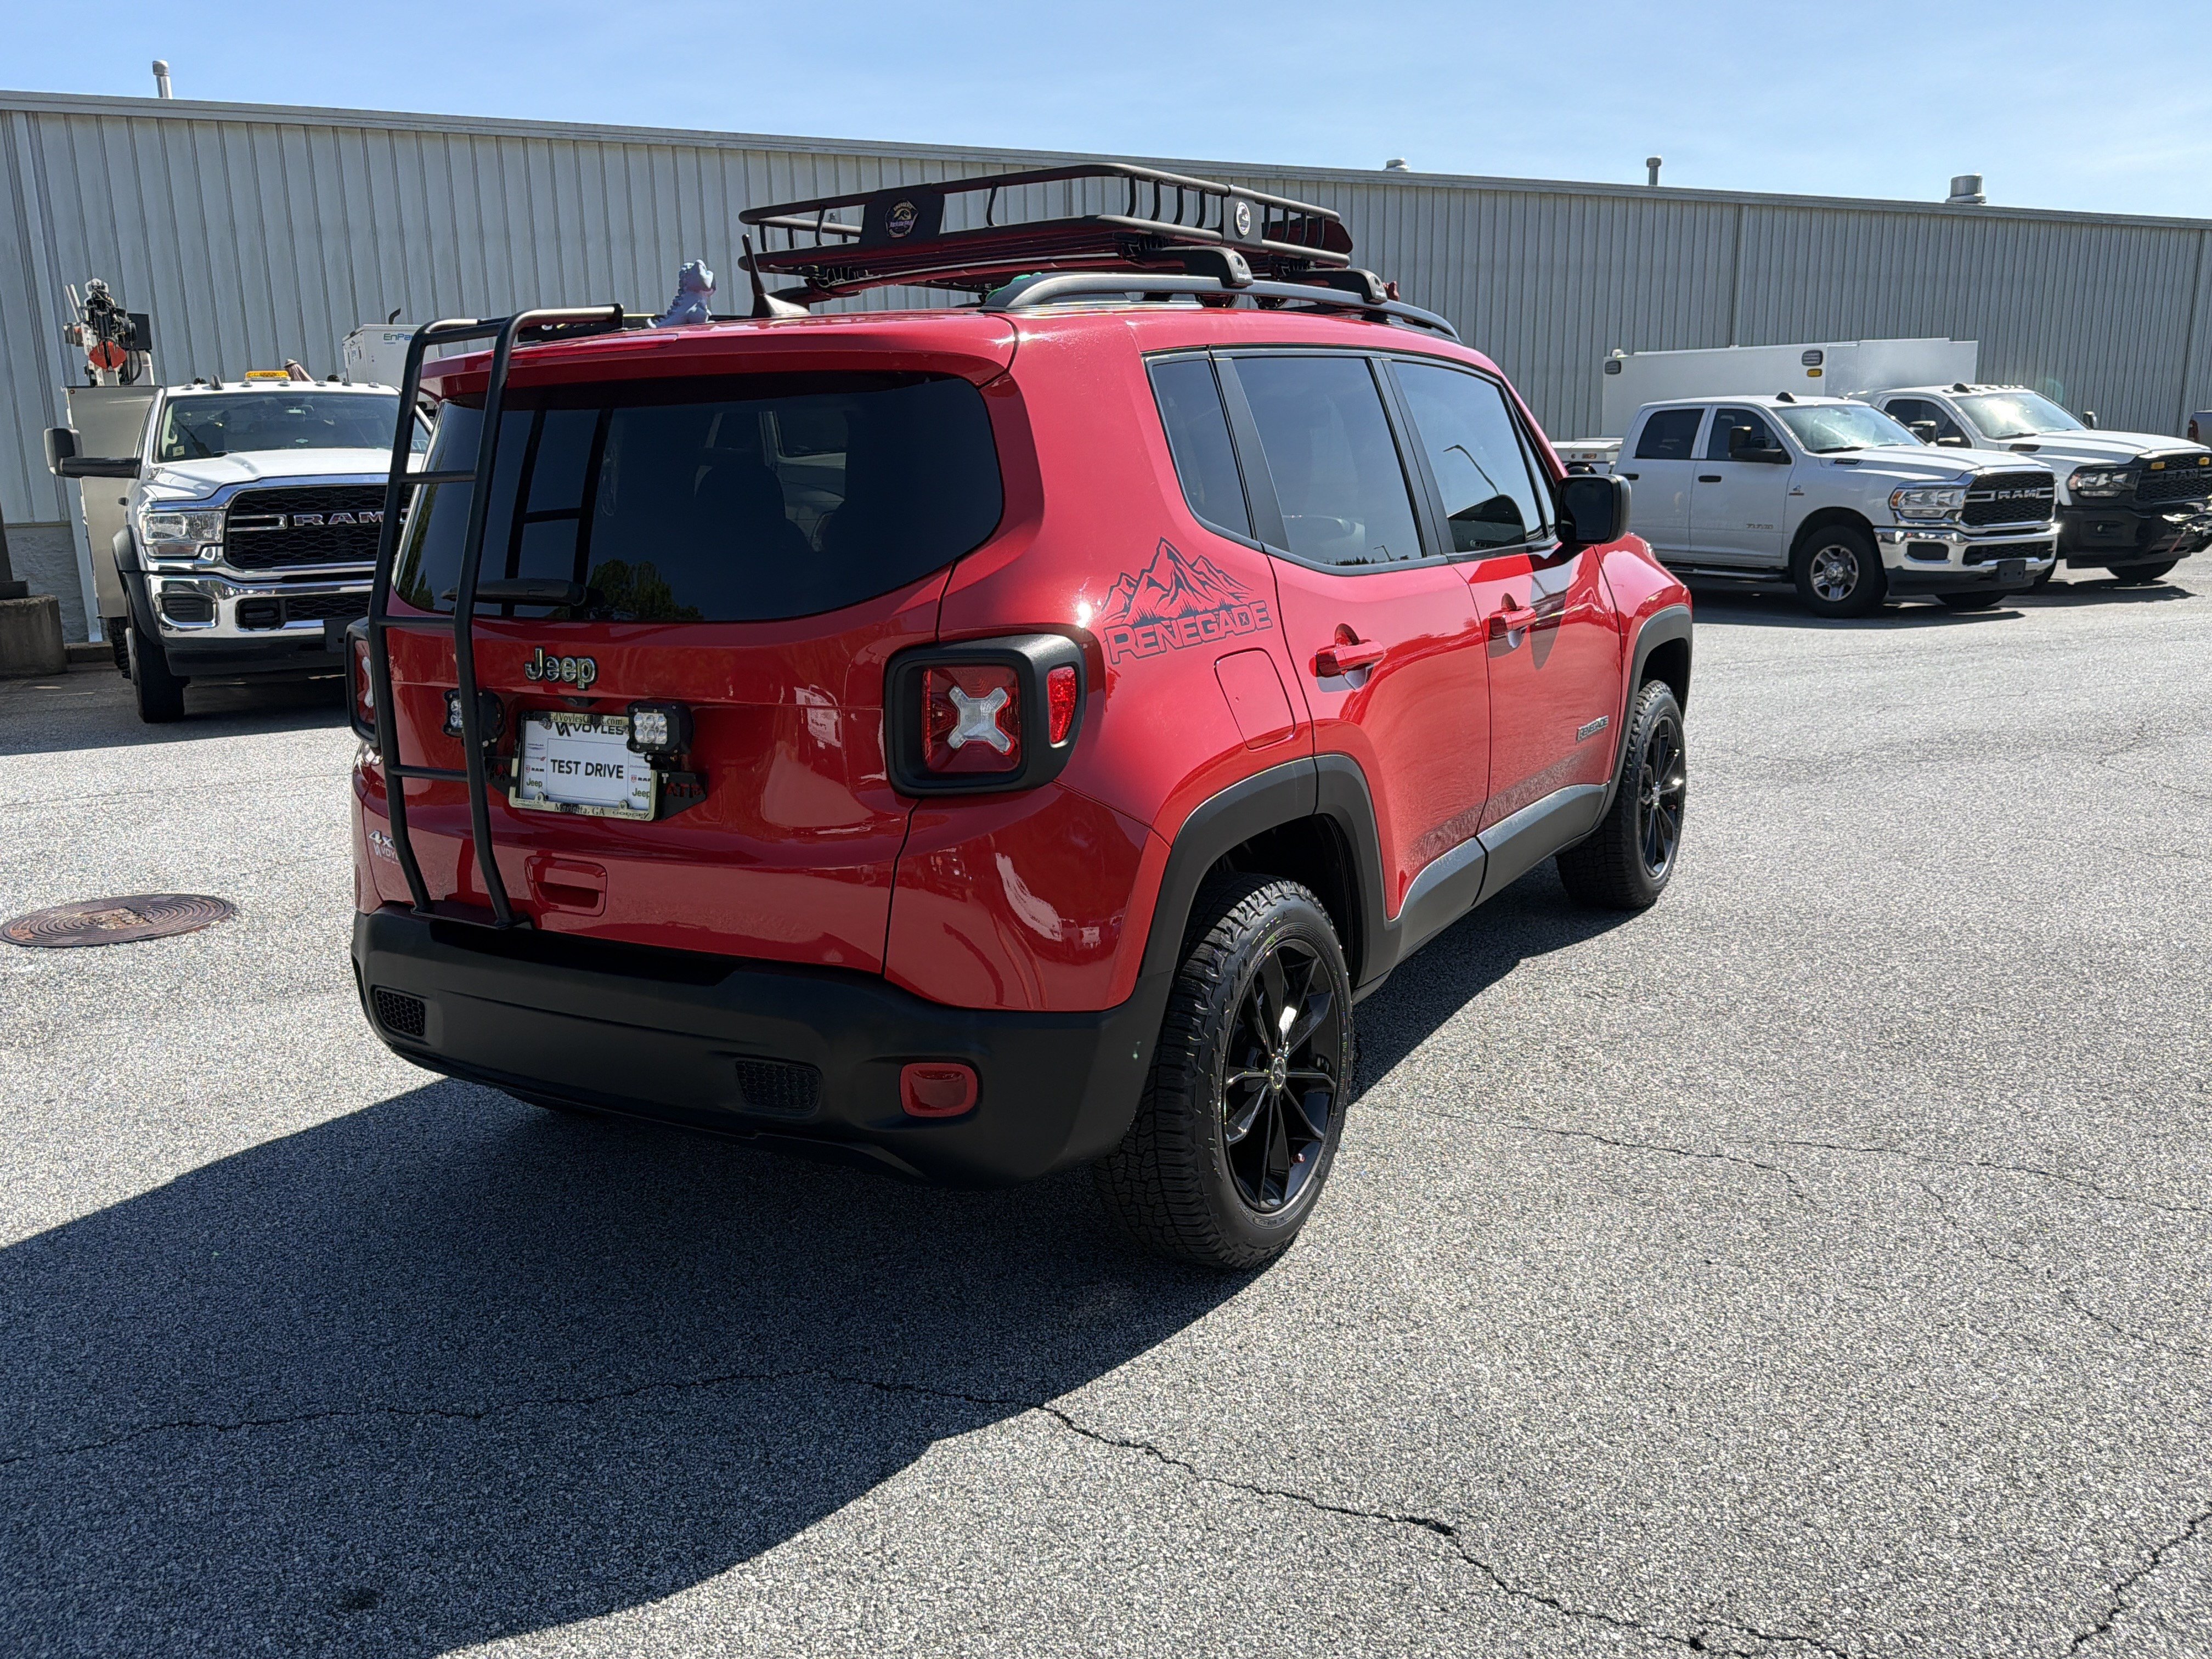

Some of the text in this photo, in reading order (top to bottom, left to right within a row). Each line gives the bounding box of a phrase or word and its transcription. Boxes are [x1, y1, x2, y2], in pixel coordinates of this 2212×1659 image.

[383, 333, 413, 341] EnPa
[1997, 489, 2036, 500] RAM
[294, 511, 385, 527] RAM
[1104, 600, 1273, 665] RENEGADE
[524, 646, 596, 690] Jeep
[572, 723, 624, 736] VOYLES
[550, 759, 624, 779] TEST DRIVE
[526, 777, 543, 789] Jeep
[592, 807, 605, 816] GA
